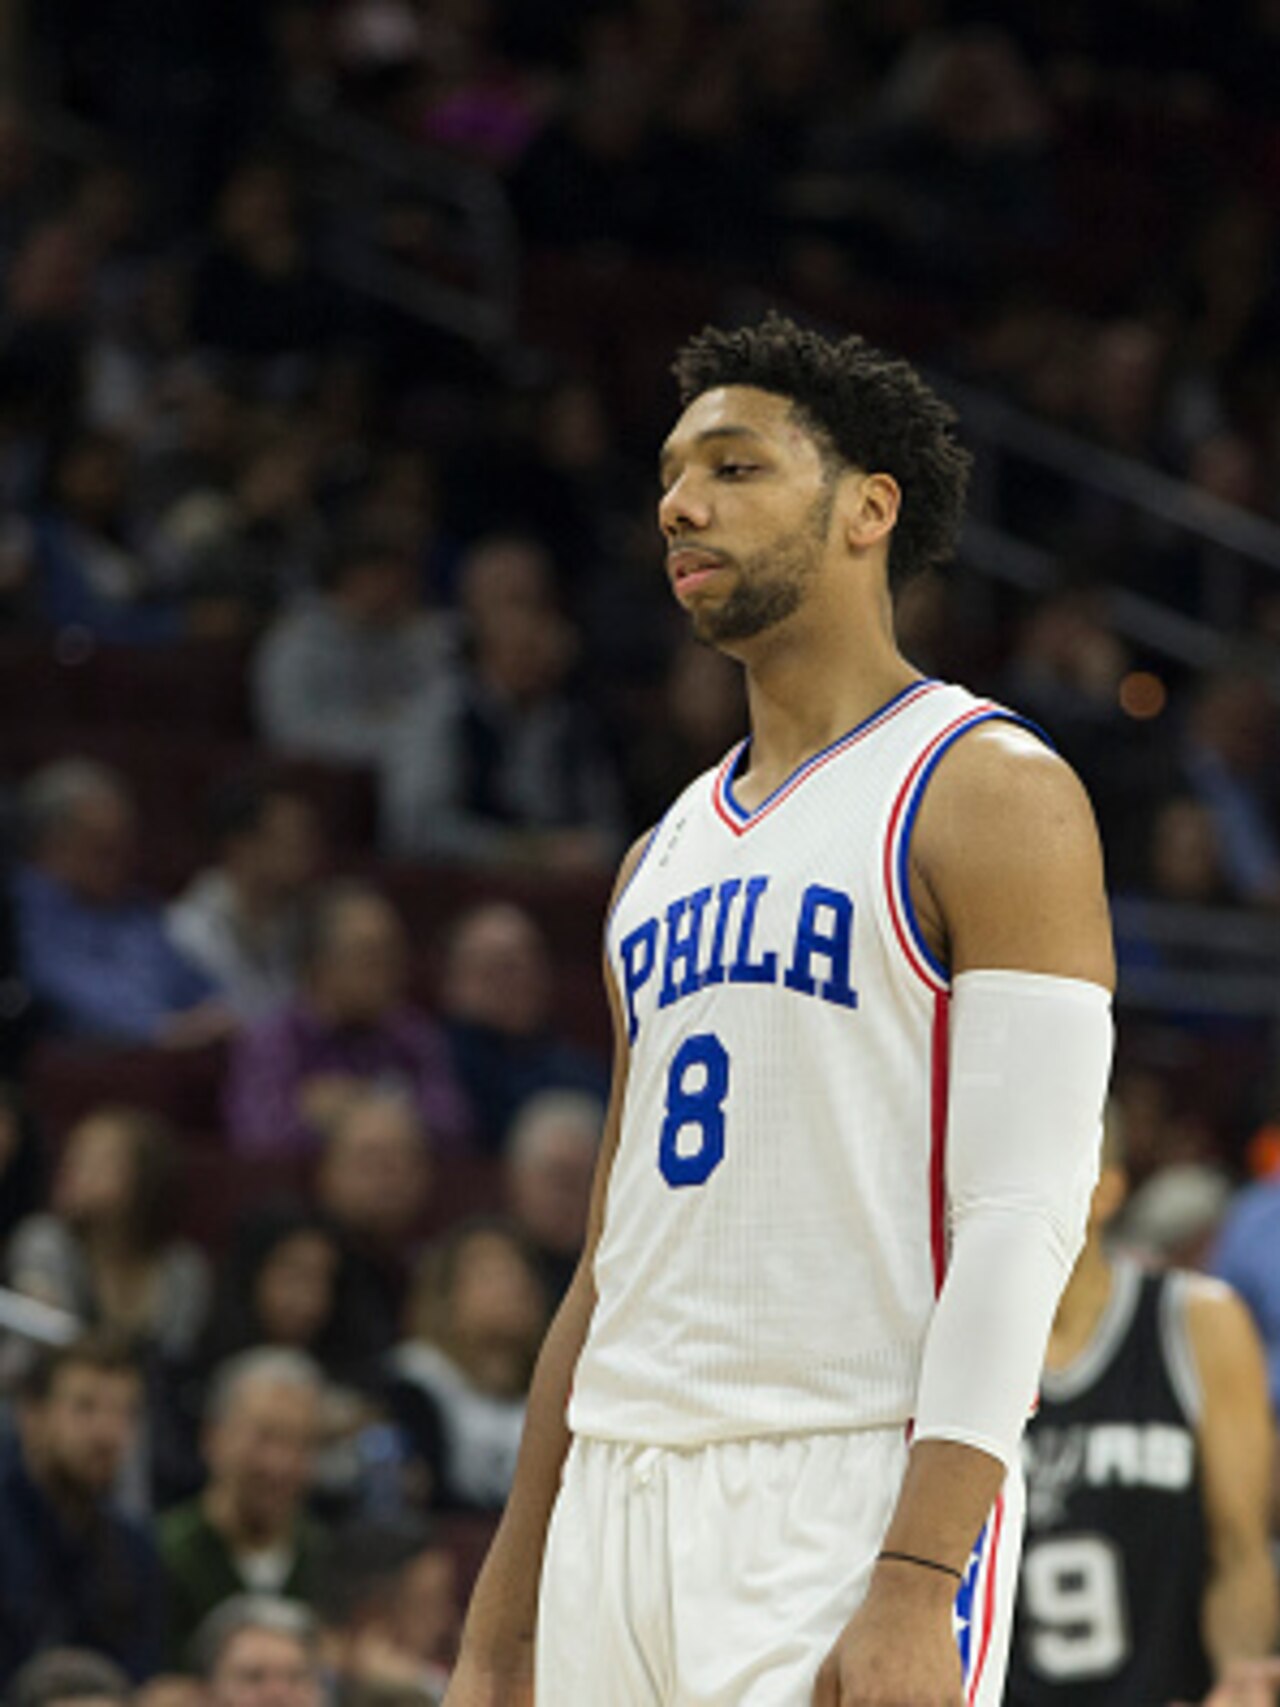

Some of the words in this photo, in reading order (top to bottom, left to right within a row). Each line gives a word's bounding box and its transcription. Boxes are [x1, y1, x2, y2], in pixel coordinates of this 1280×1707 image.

[620, 875, 858, 1047] PHILA
[657, 1032, 730, 1188] 8
[1024, 1536, 1127, 1681] 9
